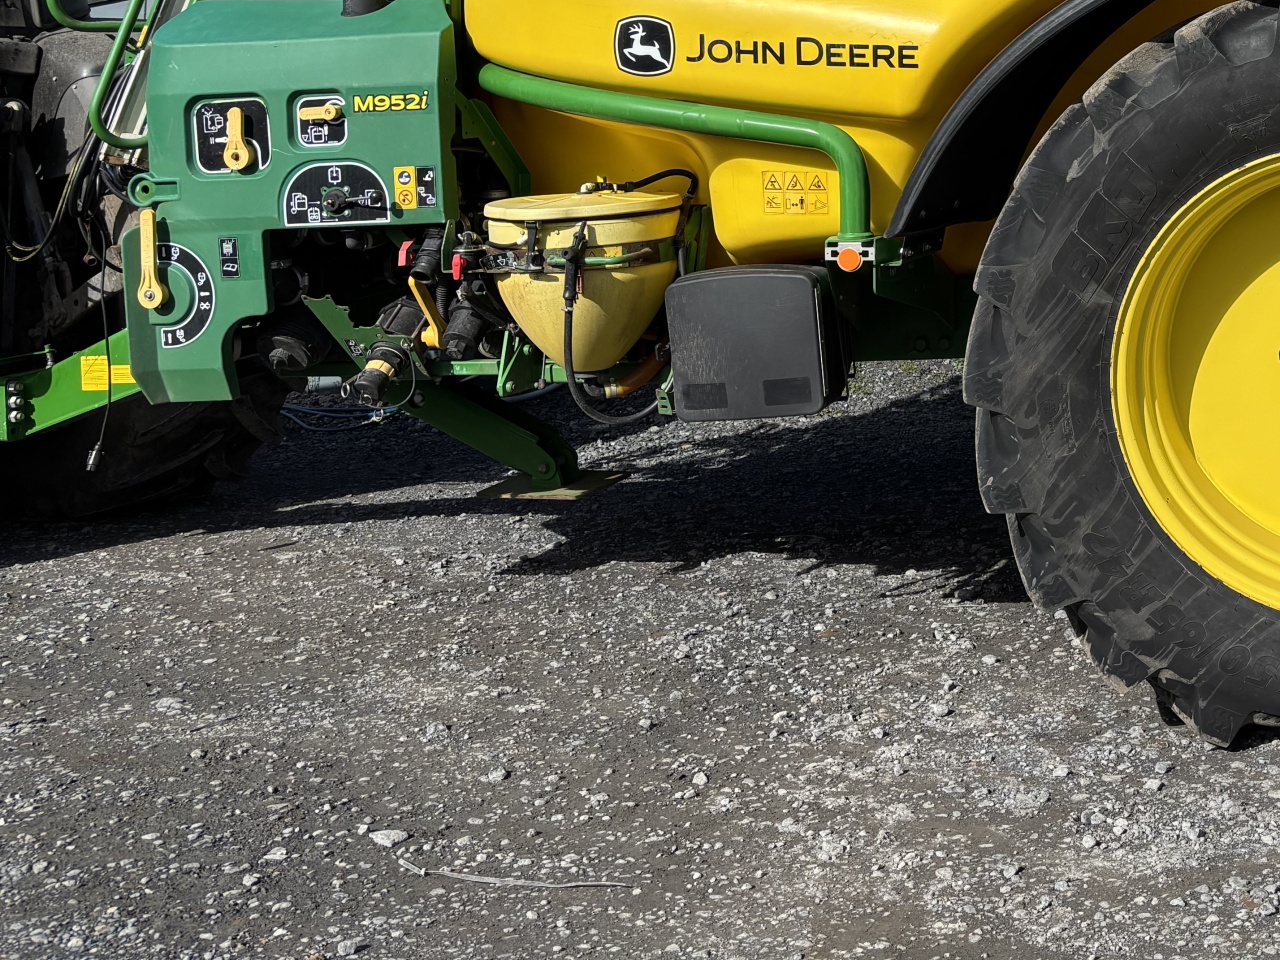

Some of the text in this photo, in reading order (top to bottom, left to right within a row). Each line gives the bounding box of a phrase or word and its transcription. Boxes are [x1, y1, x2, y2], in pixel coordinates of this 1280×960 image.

[686, 33, 919, 69] JOHN DEERE
[353, 90, 429, 113] M952i
[1052, 151, 1158, 304] BKT
